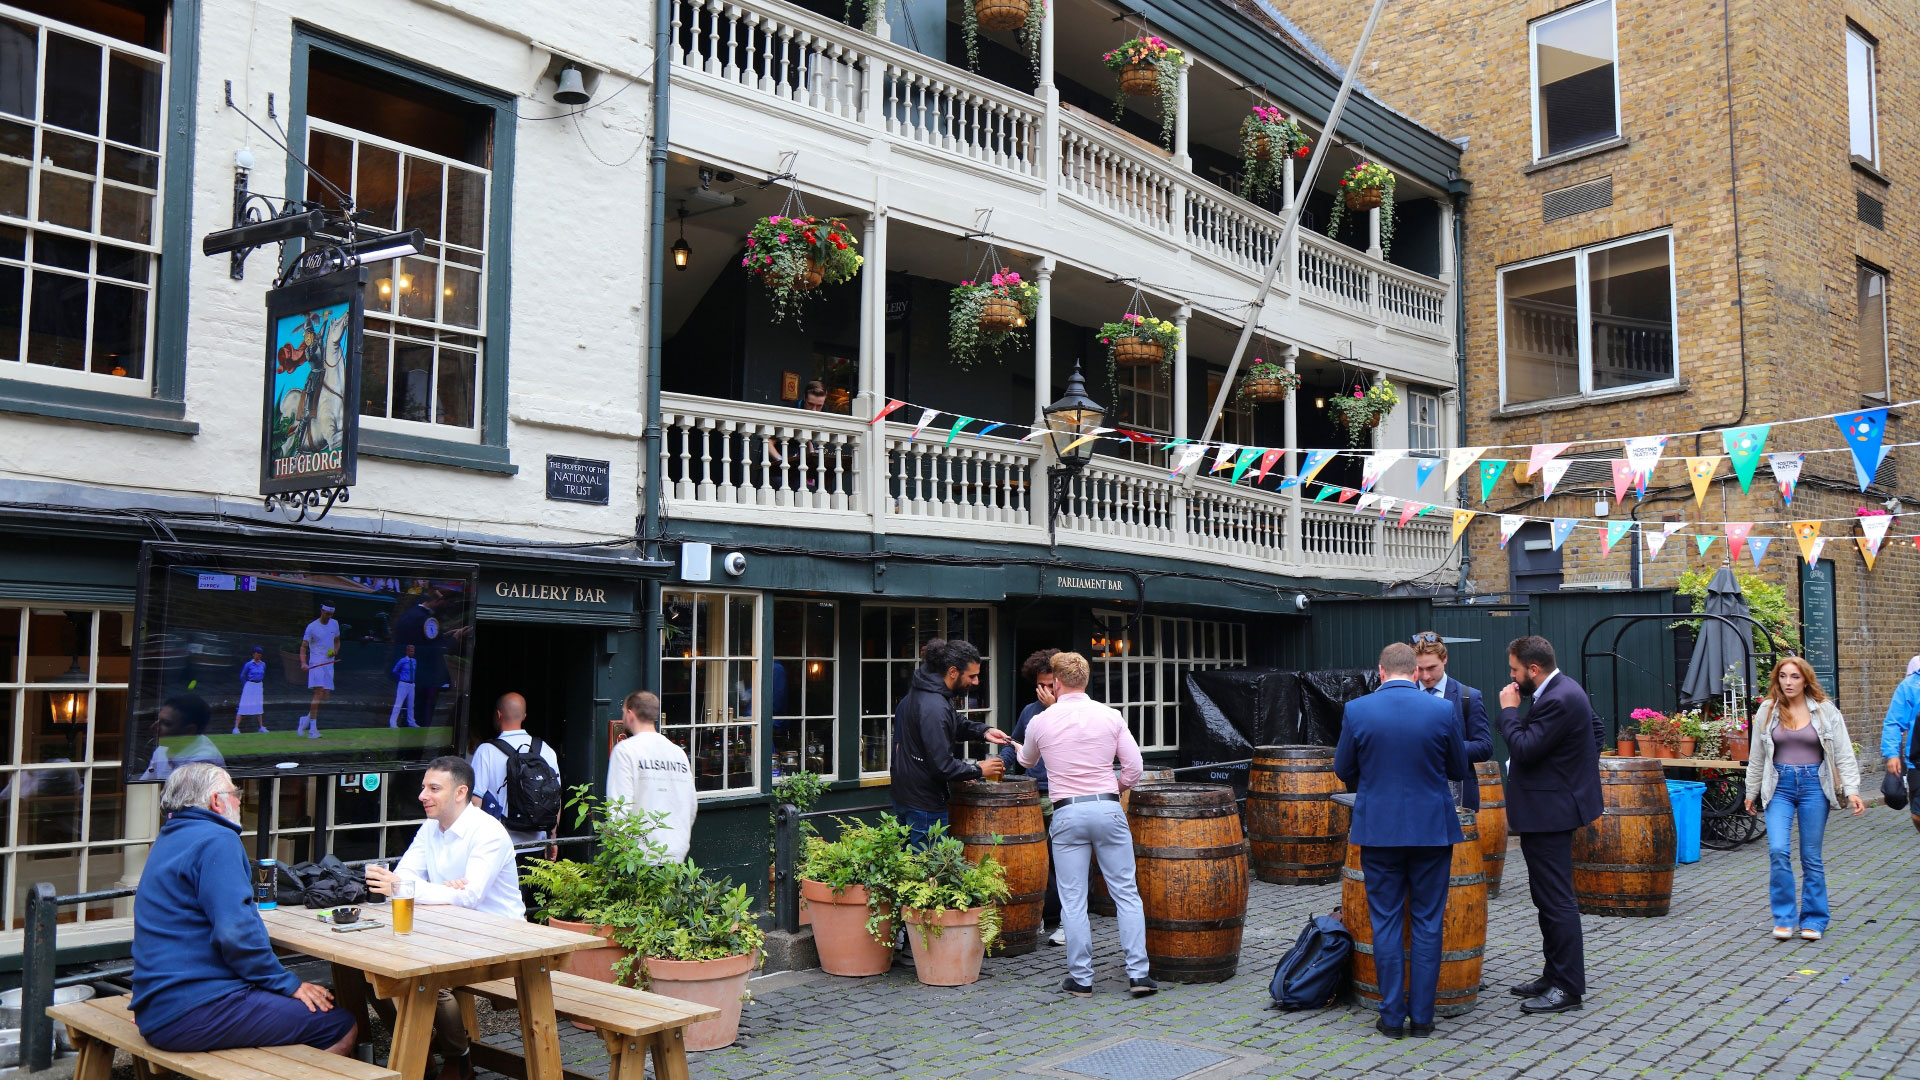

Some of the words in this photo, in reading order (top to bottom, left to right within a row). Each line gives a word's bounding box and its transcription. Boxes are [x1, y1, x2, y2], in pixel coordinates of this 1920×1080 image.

[306, 253, 323, 268] 1676
[274, 458, 295, 476] THE
[297, 450, 343, 474] GEORGE
[550, 461, 561, 469] THE
[561, 463, 589, 472] PROPERTY
[597, 467, 607, 475] THE
[554, 471, 602, 486] NATIONAL
[564, 485, 592, 496] TRUST
[1057, 576, 1107, 590] PARLIAMENT
[1108, 579, 1123, 591] BAR
[495, 581, 572, 601] GALLERY
[574, 587, 607, 604] BAR
[638, 759, 688, 774] ALLSAINTS
[1210, 771, 1230, 780] ONLY
